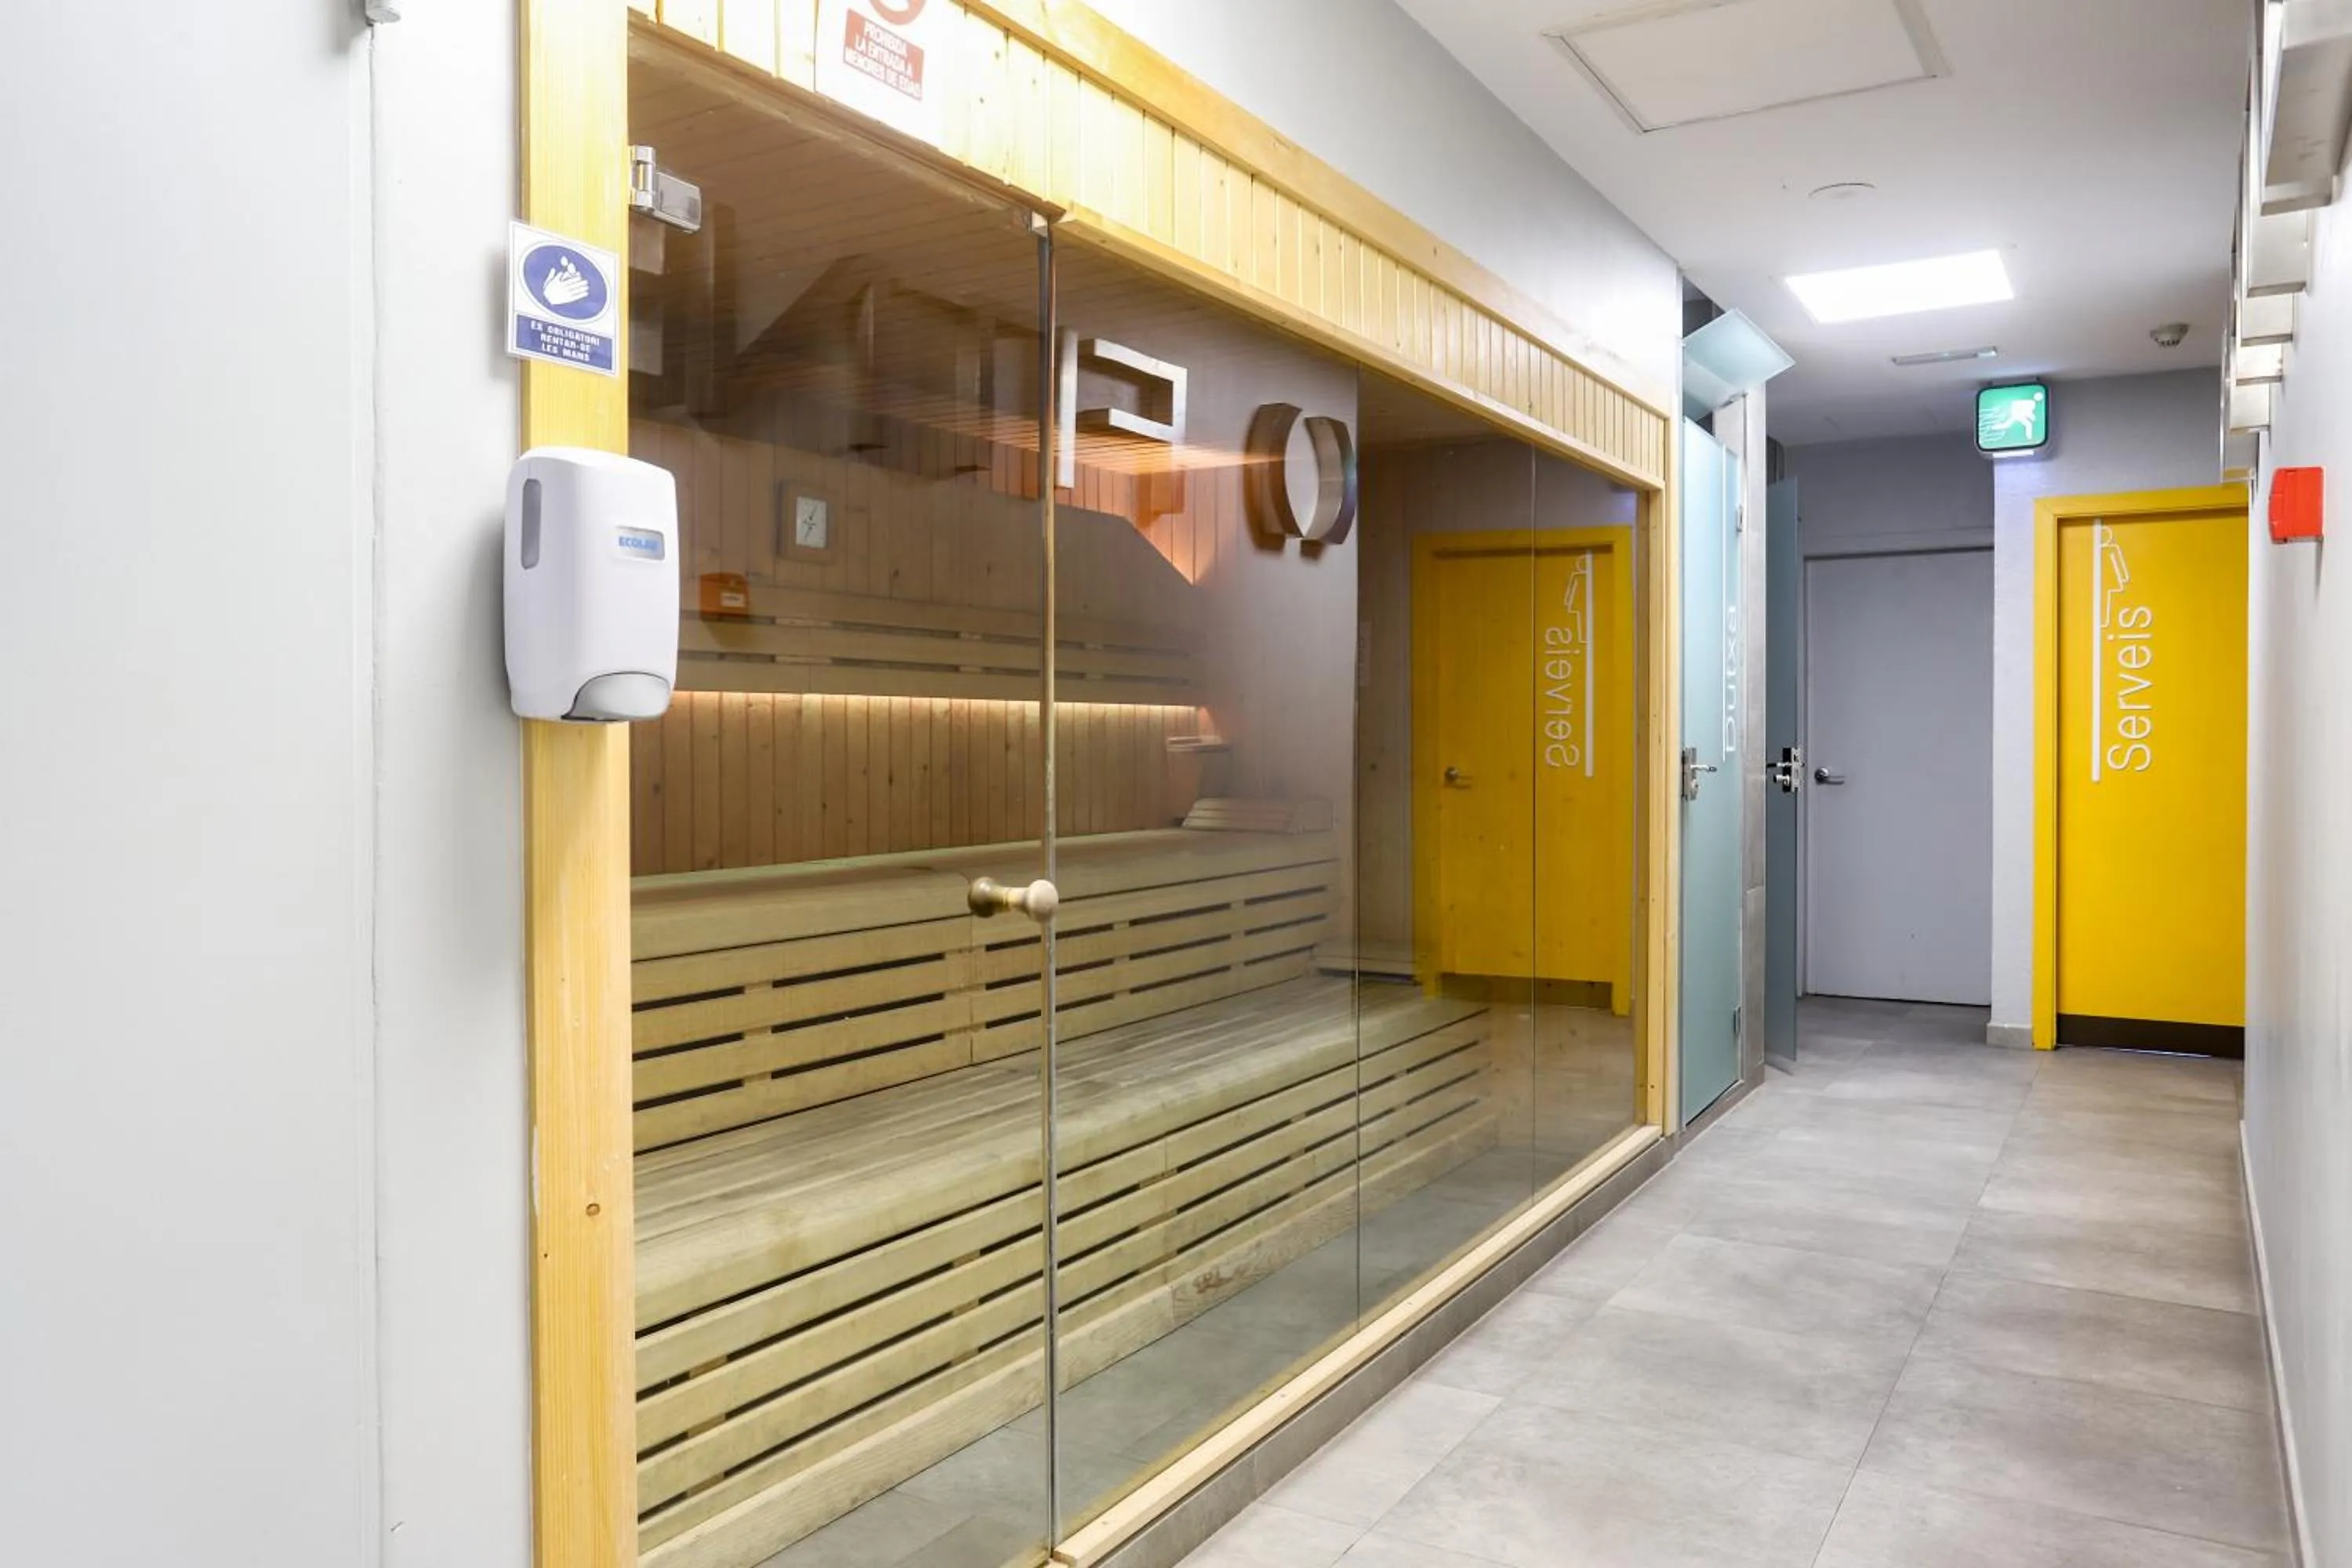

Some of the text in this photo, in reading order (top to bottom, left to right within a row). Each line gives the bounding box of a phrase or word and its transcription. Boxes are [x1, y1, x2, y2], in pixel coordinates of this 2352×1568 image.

[855, 34, 866, 54] LA
[868, 40, 906, 74] ENTRADA
[863, 20, 907, 59] PROHIBIDA
[540, 332, 590, 352] RENTAR-SE
[542, 343, 590, 361] LES MANS
[547, 325, 600, 346] OBLIGATORI
[1726, 604, 1737, 753] Dutxa
[2107, 605, 2153, 771] Serveis
